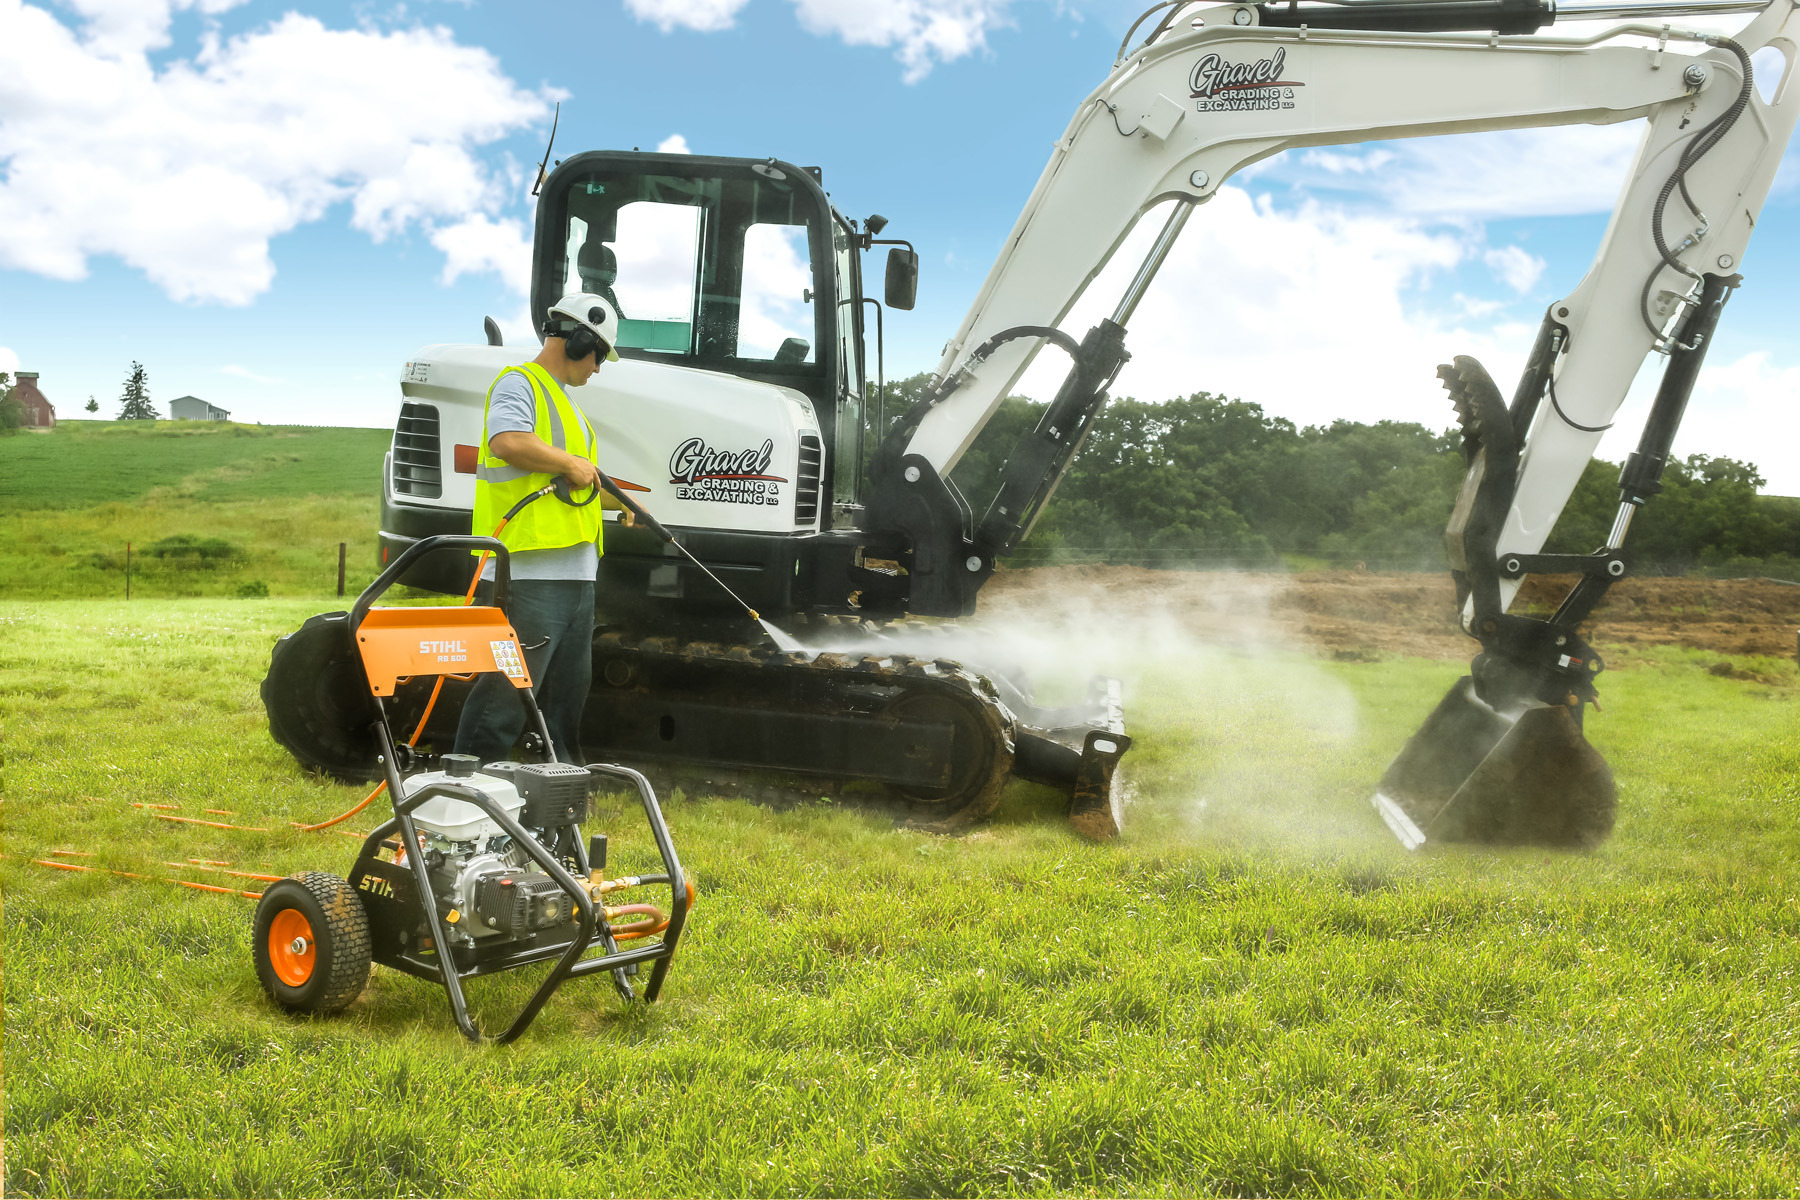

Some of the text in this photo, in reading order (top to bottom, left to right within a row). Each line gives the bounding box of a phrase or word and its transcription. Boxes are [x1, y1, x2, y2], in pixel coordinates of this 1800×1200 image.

[1189, 47, 1286, 99] Gravel
[1219, 87, 1294, 100] GRADING &
[1197, 99, 1294, 112] EXCAVATING LLC
[669, 437, 774, 486] Gravel
[701, 478, 779, 494] GRADING &
[676, 487, 779, 505] EXCAVATING LLC
[419, 640, 467, 654] STIHL
[450, 654, 467, 662] 600
[359, 874, 398, 900] STIH
